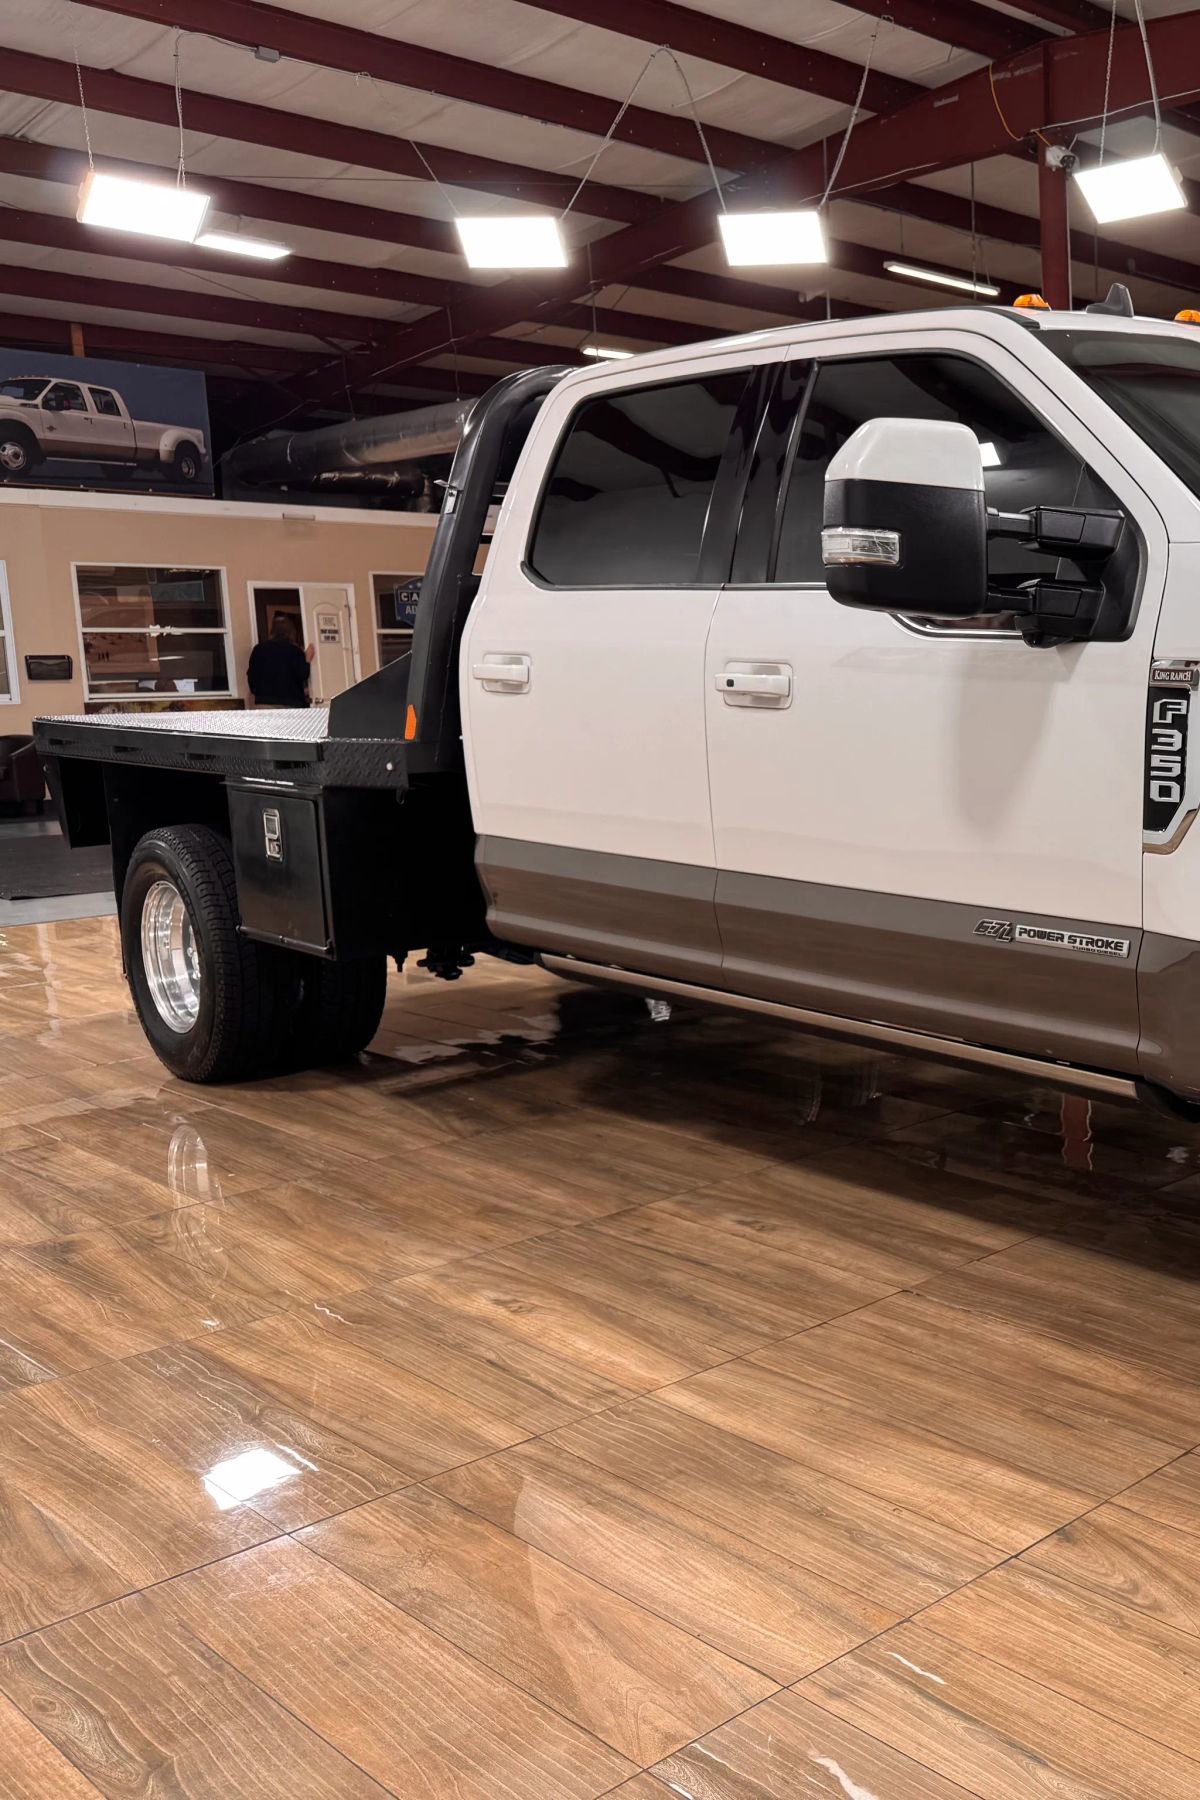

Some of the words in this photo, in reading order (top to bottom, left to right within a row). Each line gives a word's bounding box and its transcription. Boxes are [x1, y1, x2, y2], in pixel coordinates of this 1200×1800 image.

[1154, 670, 1170, 681] KING
[1170, 671, 1192, 681] RANCH
[1150, 698, 1188, 803] F350
[1018, 927, 1065, 944] POWER
[1067, 934, 1125, 952] STROKE
